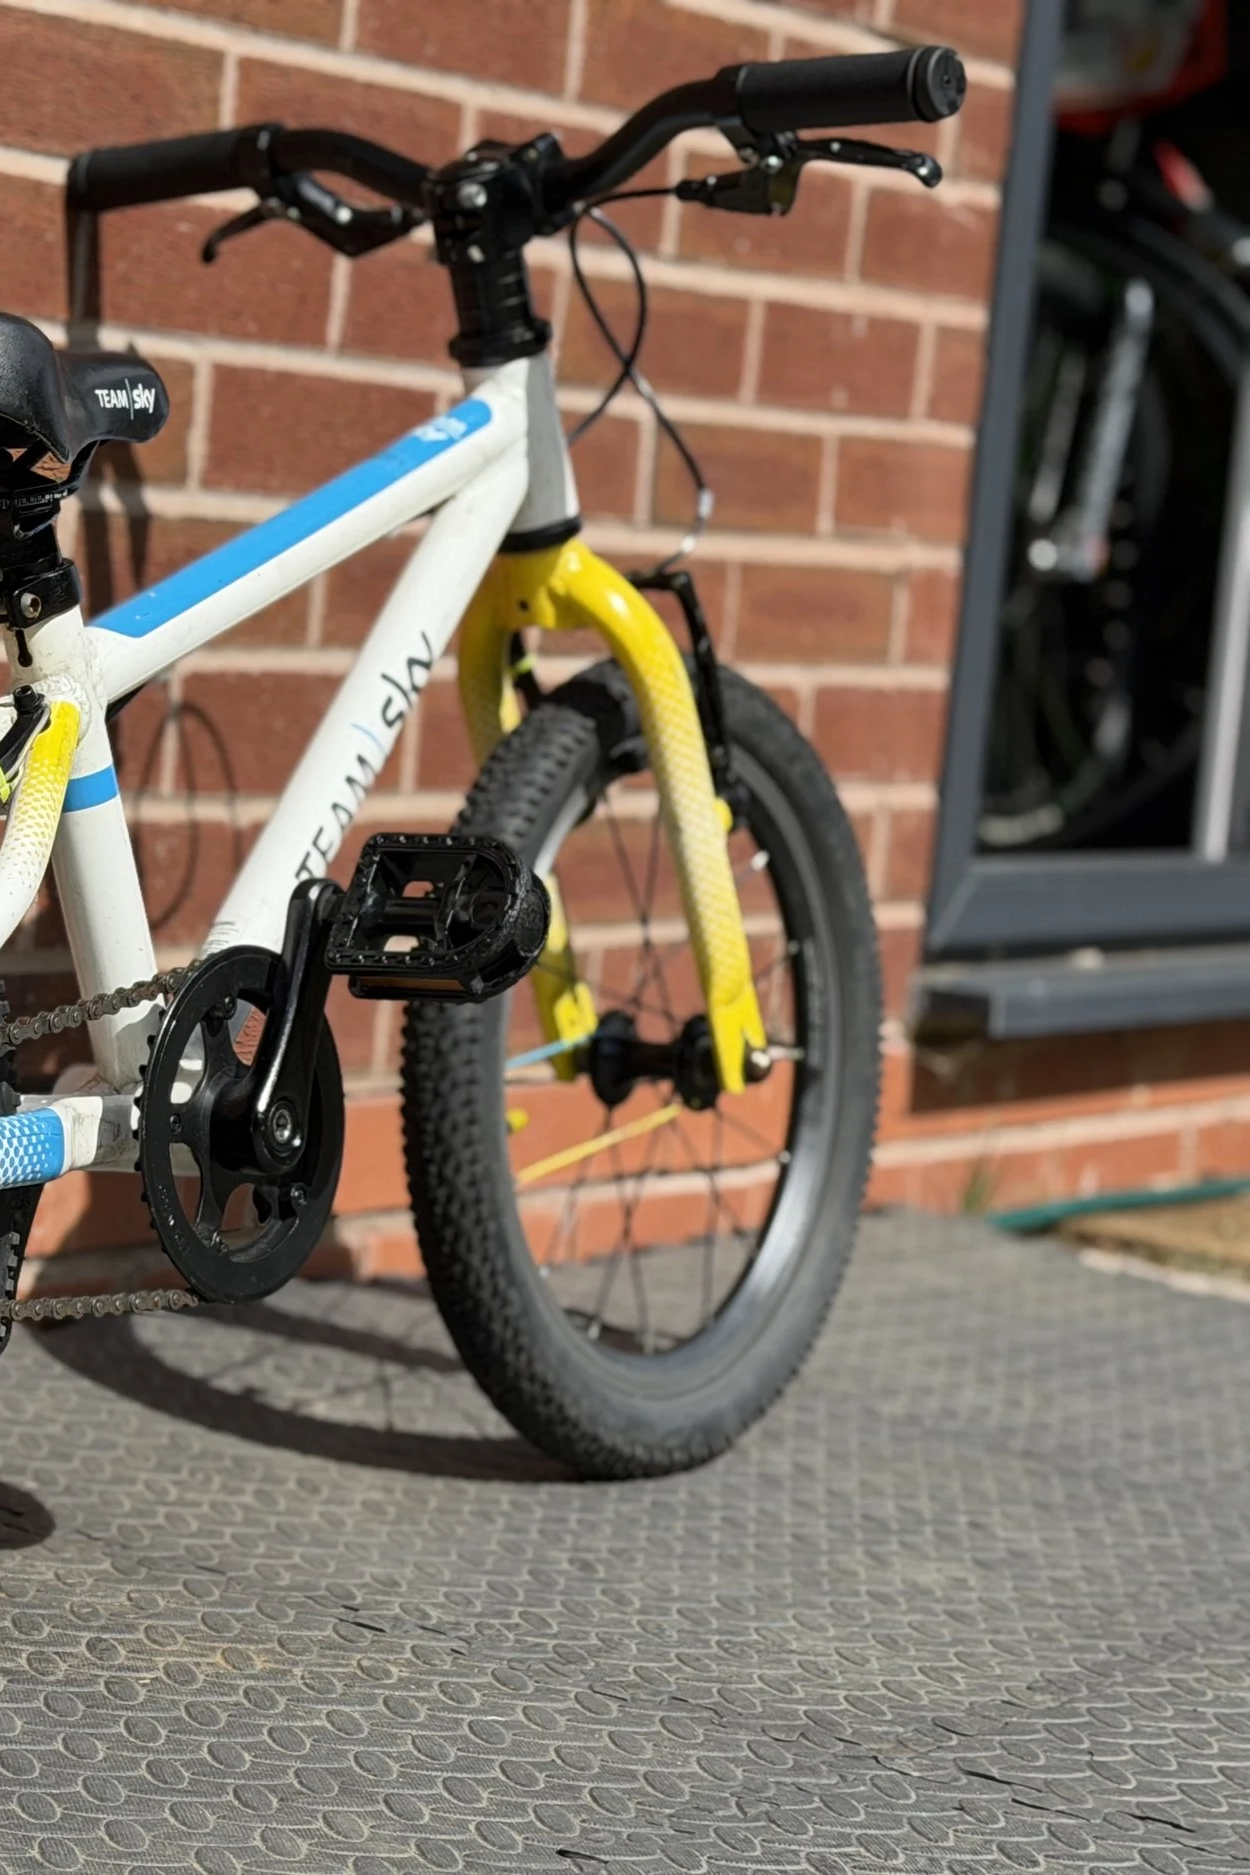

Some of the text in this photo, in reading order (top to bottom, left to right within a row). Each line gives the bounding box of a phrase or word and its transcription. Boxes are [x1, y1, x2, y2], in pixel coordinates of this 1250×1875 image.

[94, 382, 156, 414] TEAM sky
[294, 753, 380, 882] TEAM
